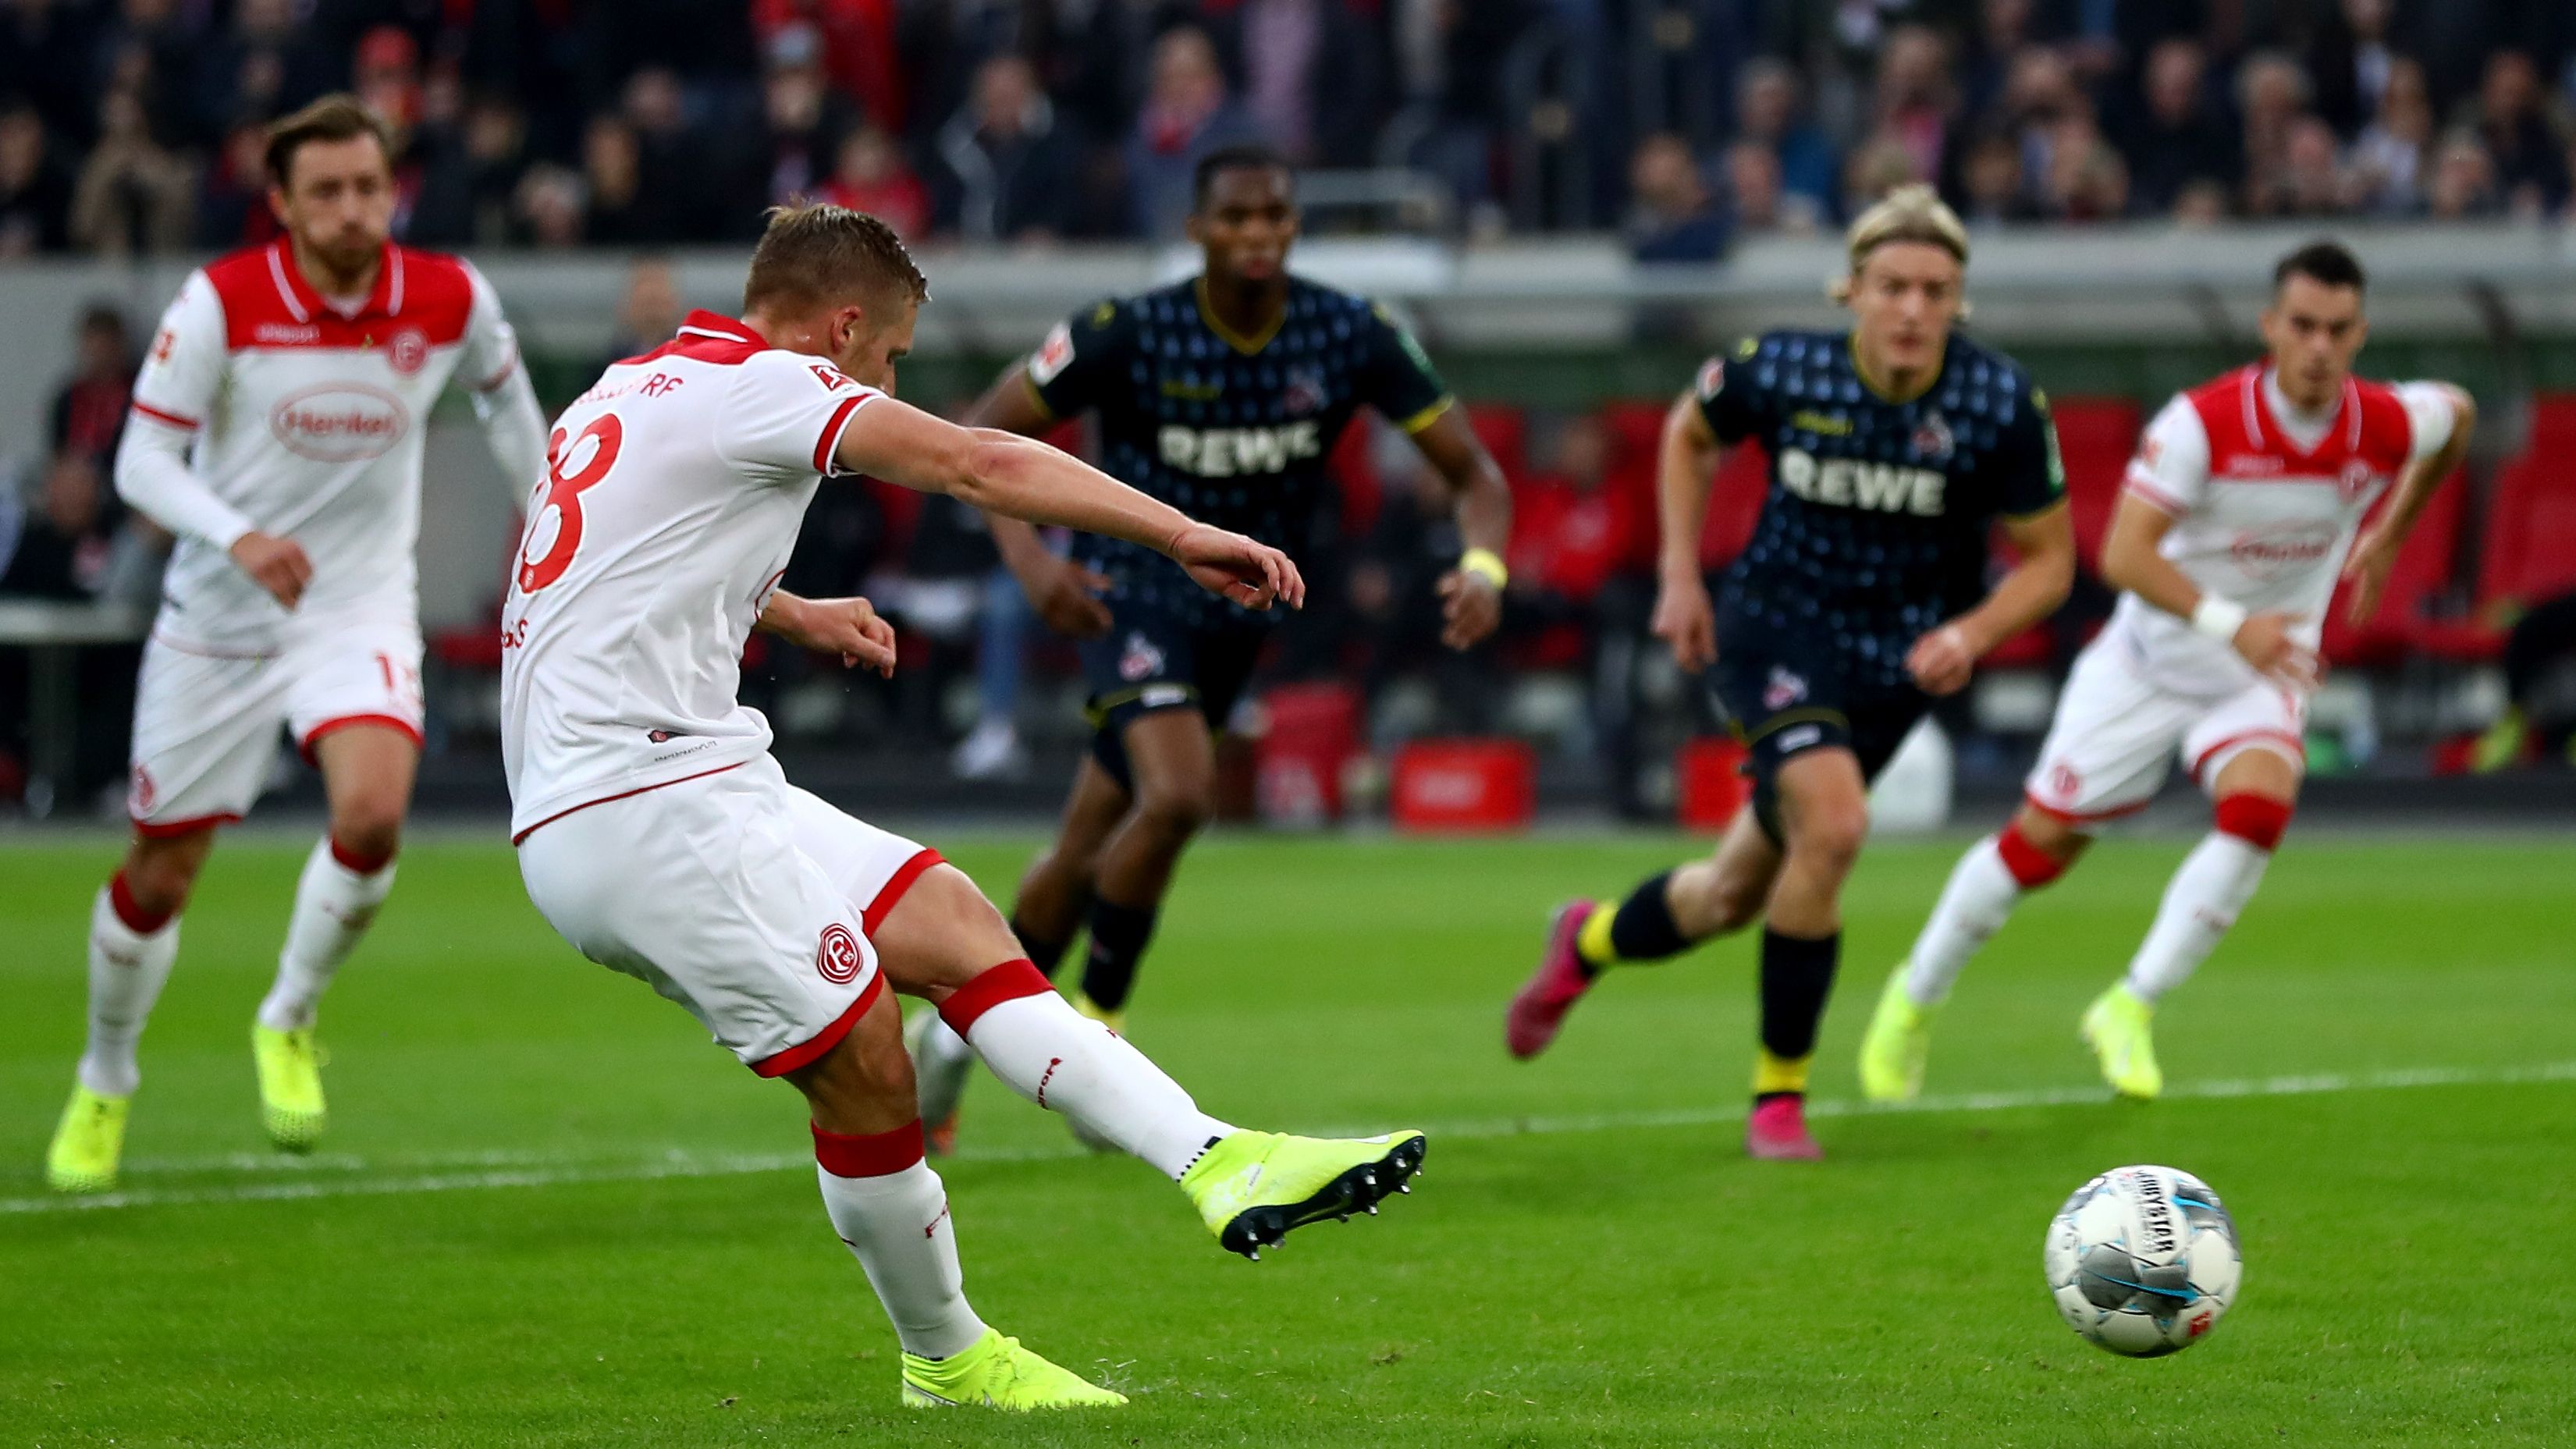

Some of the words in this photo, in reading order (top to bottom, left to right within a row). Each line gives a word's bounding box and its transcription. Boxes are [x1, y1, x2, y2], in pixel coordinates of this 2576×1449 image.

[1158, 420, 1320, 478] REWE
[1779, 448, 1947, 516] REWE
[519, 413, 623, 594] 8
